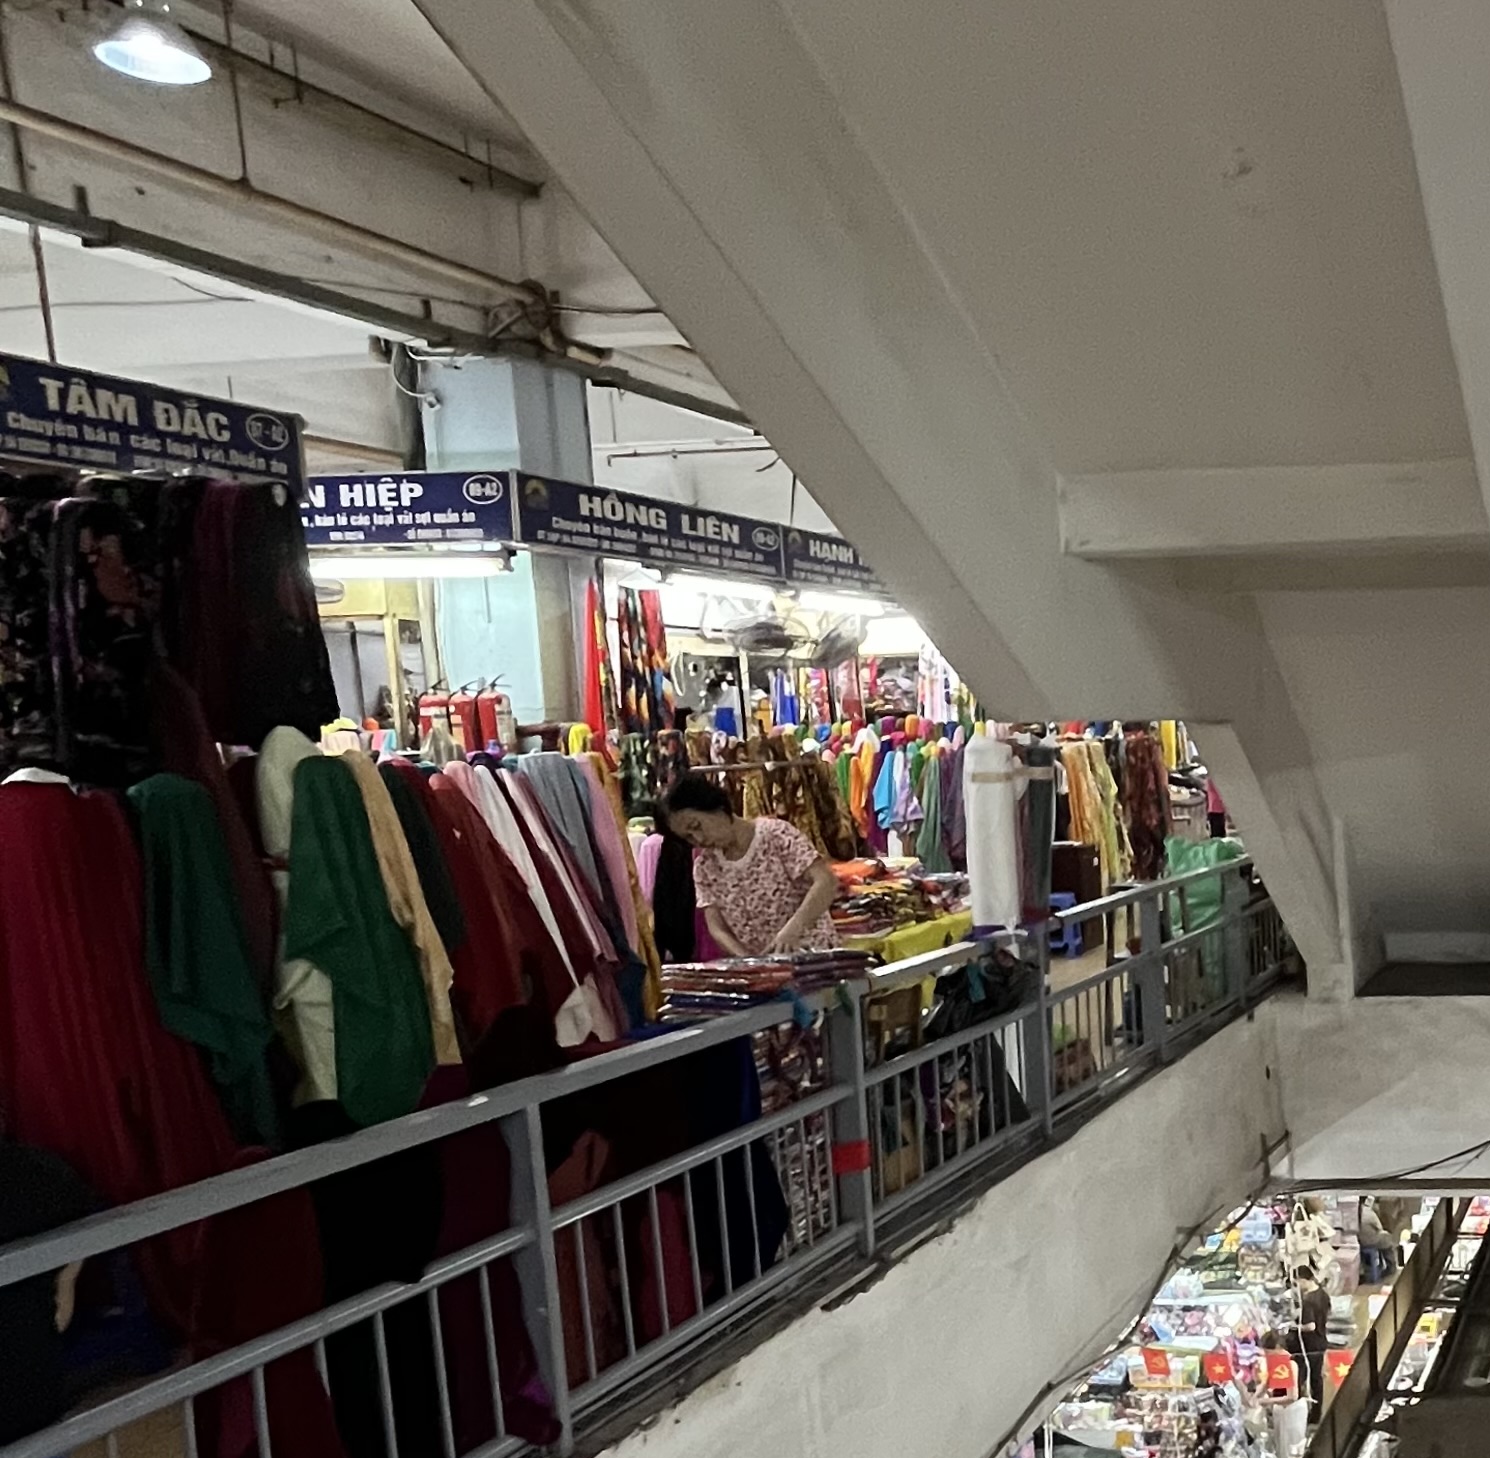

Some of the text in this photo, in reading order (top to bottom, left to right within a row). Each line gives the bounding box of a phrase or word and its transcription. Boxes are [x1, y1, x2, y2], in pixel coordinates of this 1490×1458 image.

[38, 376, 138, 427] TÂM
[339, 476, 424, 512] HIỆP
[681, 513, 740, 545] LIÊN
